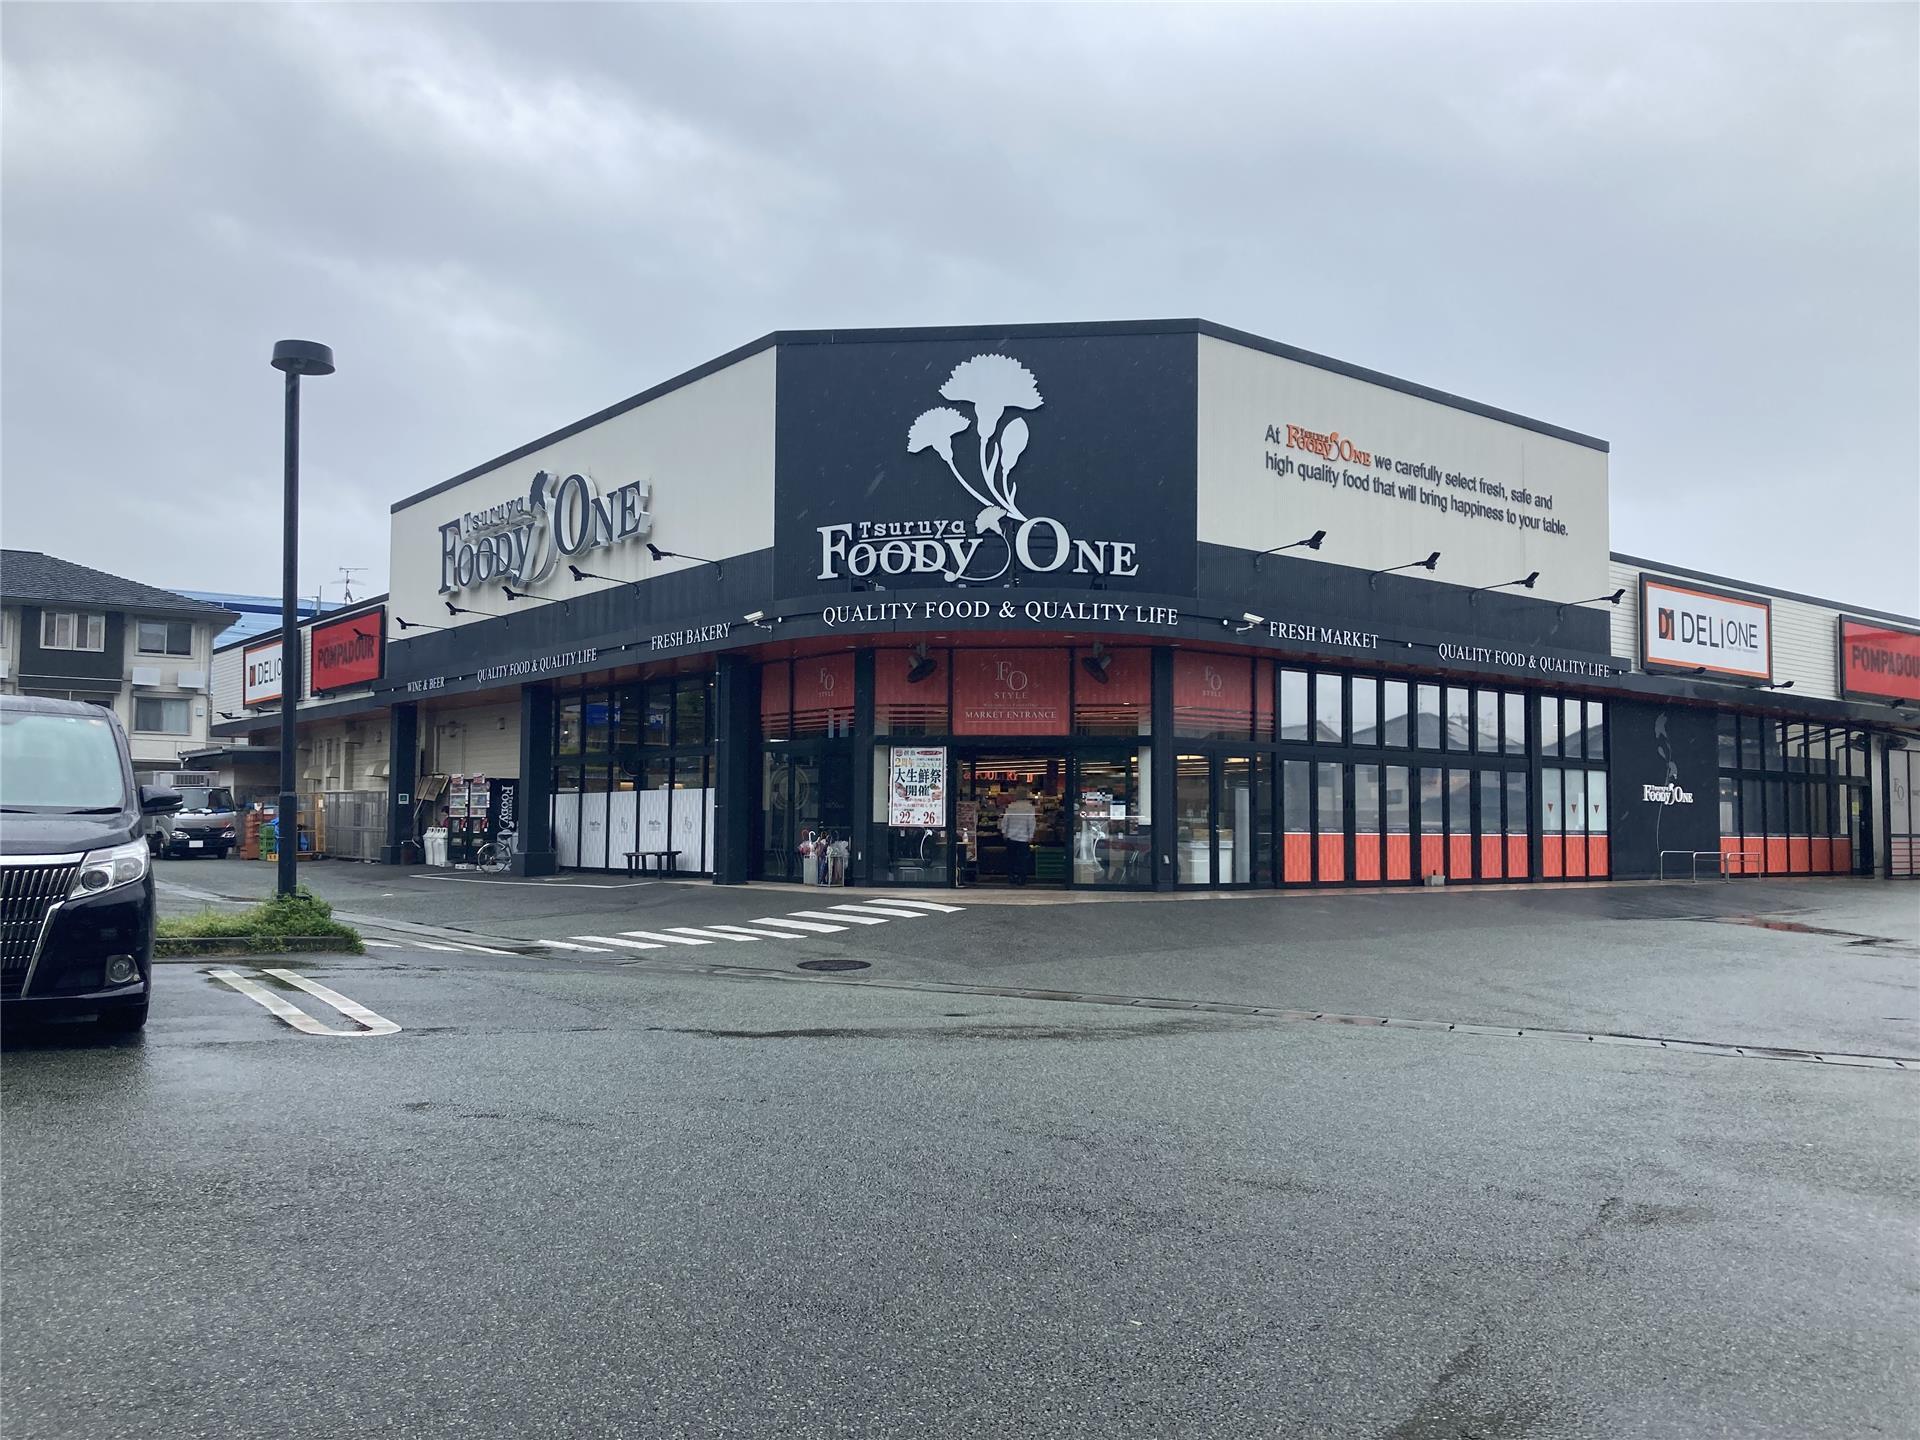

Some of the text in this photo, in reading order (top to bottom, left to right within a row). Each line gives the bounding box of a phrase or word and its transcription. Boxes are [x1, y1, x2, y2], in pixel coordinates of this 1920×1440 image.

[1265, 424, 1280, 444] At
[1340, 440, 1371, 466] ONE
[1374, 455, 1392, 471] we
[1395, 460, 1442, 486] carefully
[1445, 472, 1477, 492] select
[1479, 478, 1508, 500] fresh,
[1511, 488, 1531, 505] safe
[1534, 495, 1552, 510] and
[1265, 451, 1569, 536] high quality food that will bring happiness to your table.
[464, 496, 524, 533] Tsuruya
[554, 473, 644, 556] ONE
[859, 520, 966, 538] Tsuruya
[1014, 517, 1139, 576] ONE
[823, 600, 1178, 626] QUALITY FOOD & QUALITY LIFE
[651, 622, 731, 650] FRESH BAKERY
[1269, 621, 1379, 649] FRESH MARKET
[318, 635, 376, 671] POMPADOUR
[477, 647, 597, 682] QUALITY FOOD & QUALITY LIFE
[1438, 643, 1610, 678] QUALITY FOOD & QUALITY LIFE
[407, 676, 445, 693] WINE & BEER
[965, 711, 1057, 719] MARKET ENTRANCE
[895, 768, 941, 783] 大生鮮祭
[906, 785, 930, 797] 開催
[900, 812, 935, 824] 22 26
